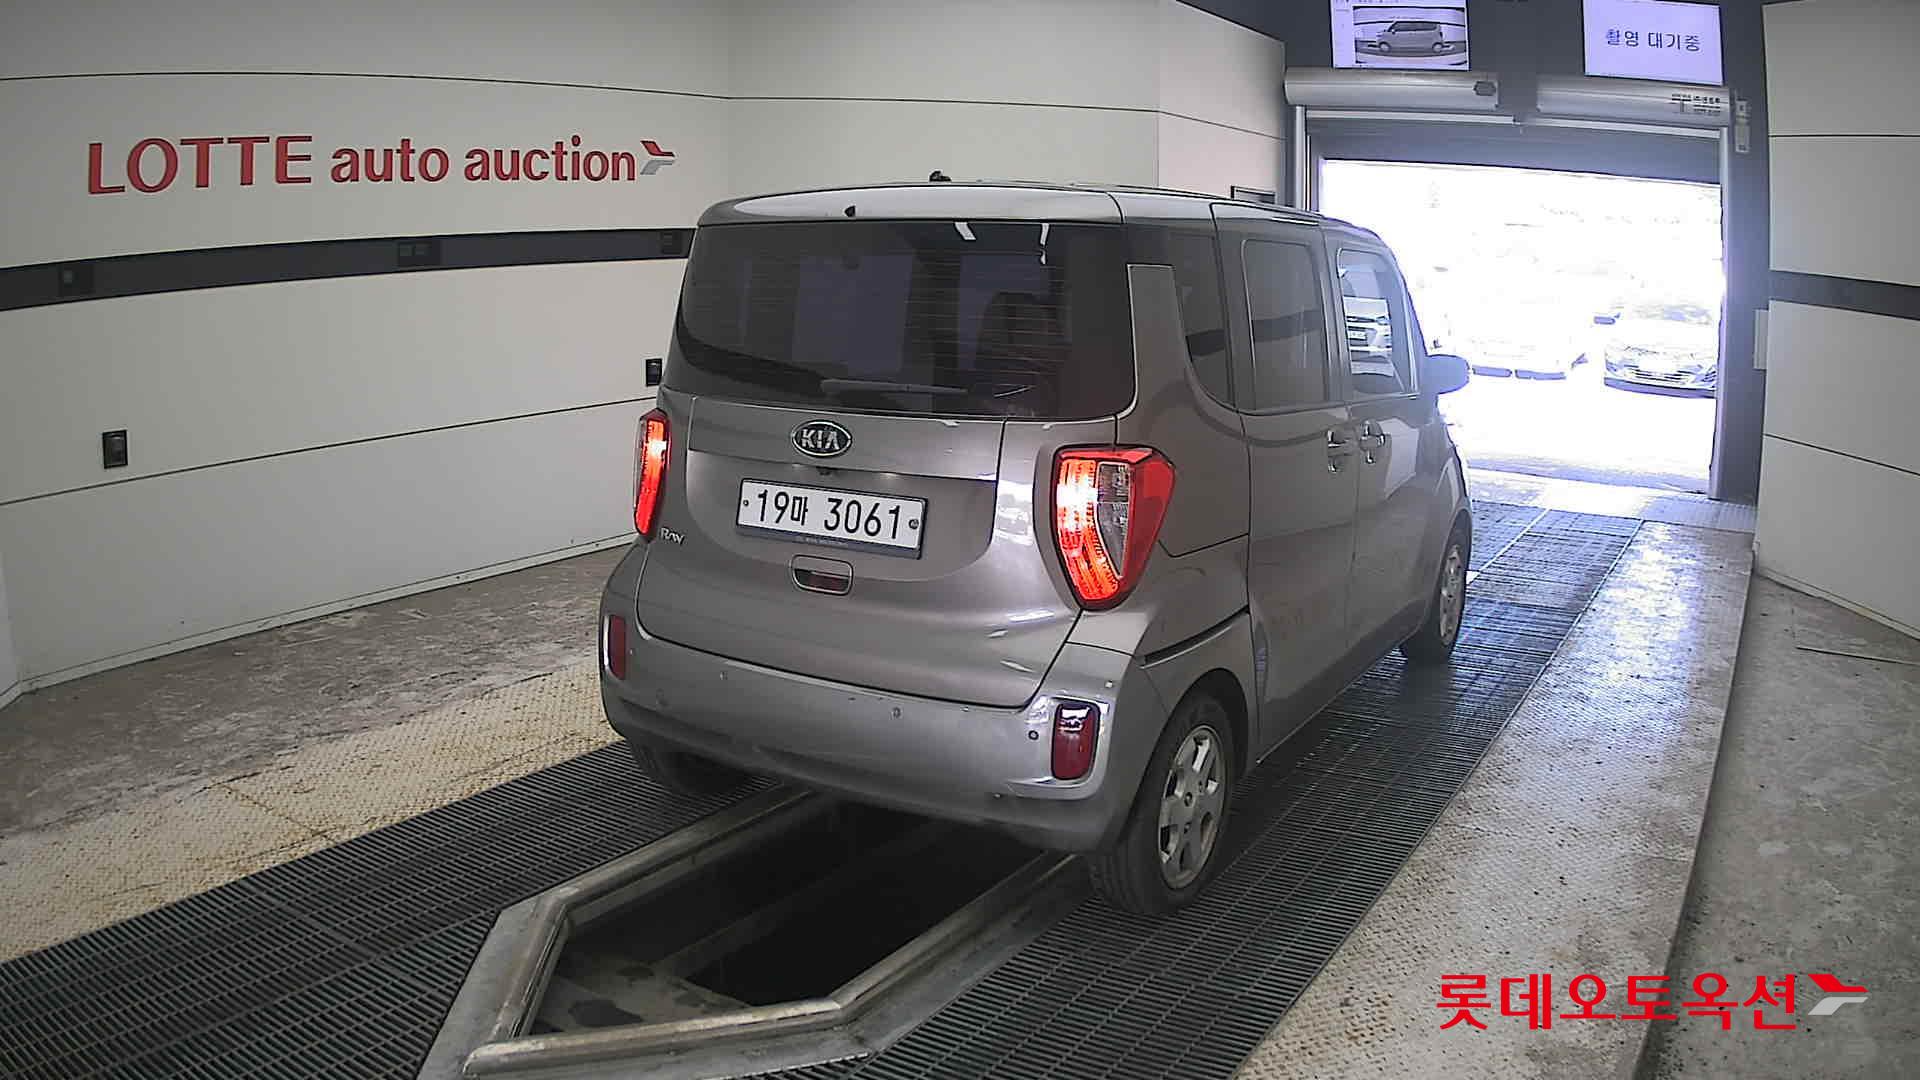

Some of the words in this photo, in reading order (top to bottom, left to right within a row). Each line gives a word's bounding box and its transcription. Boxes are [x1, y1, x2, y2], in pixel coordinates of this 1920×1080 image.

[1647, 31, 1701, 52] 대기중
[88, 135, 313, 195] LOTTE
[330, 138, 450, 184] auto
[463, 134, 636, 182] auction
[800, 428, 842, 450] KIA
[757, 488, 809, 527] 19마
[823, 497, 901, 540] 3061
